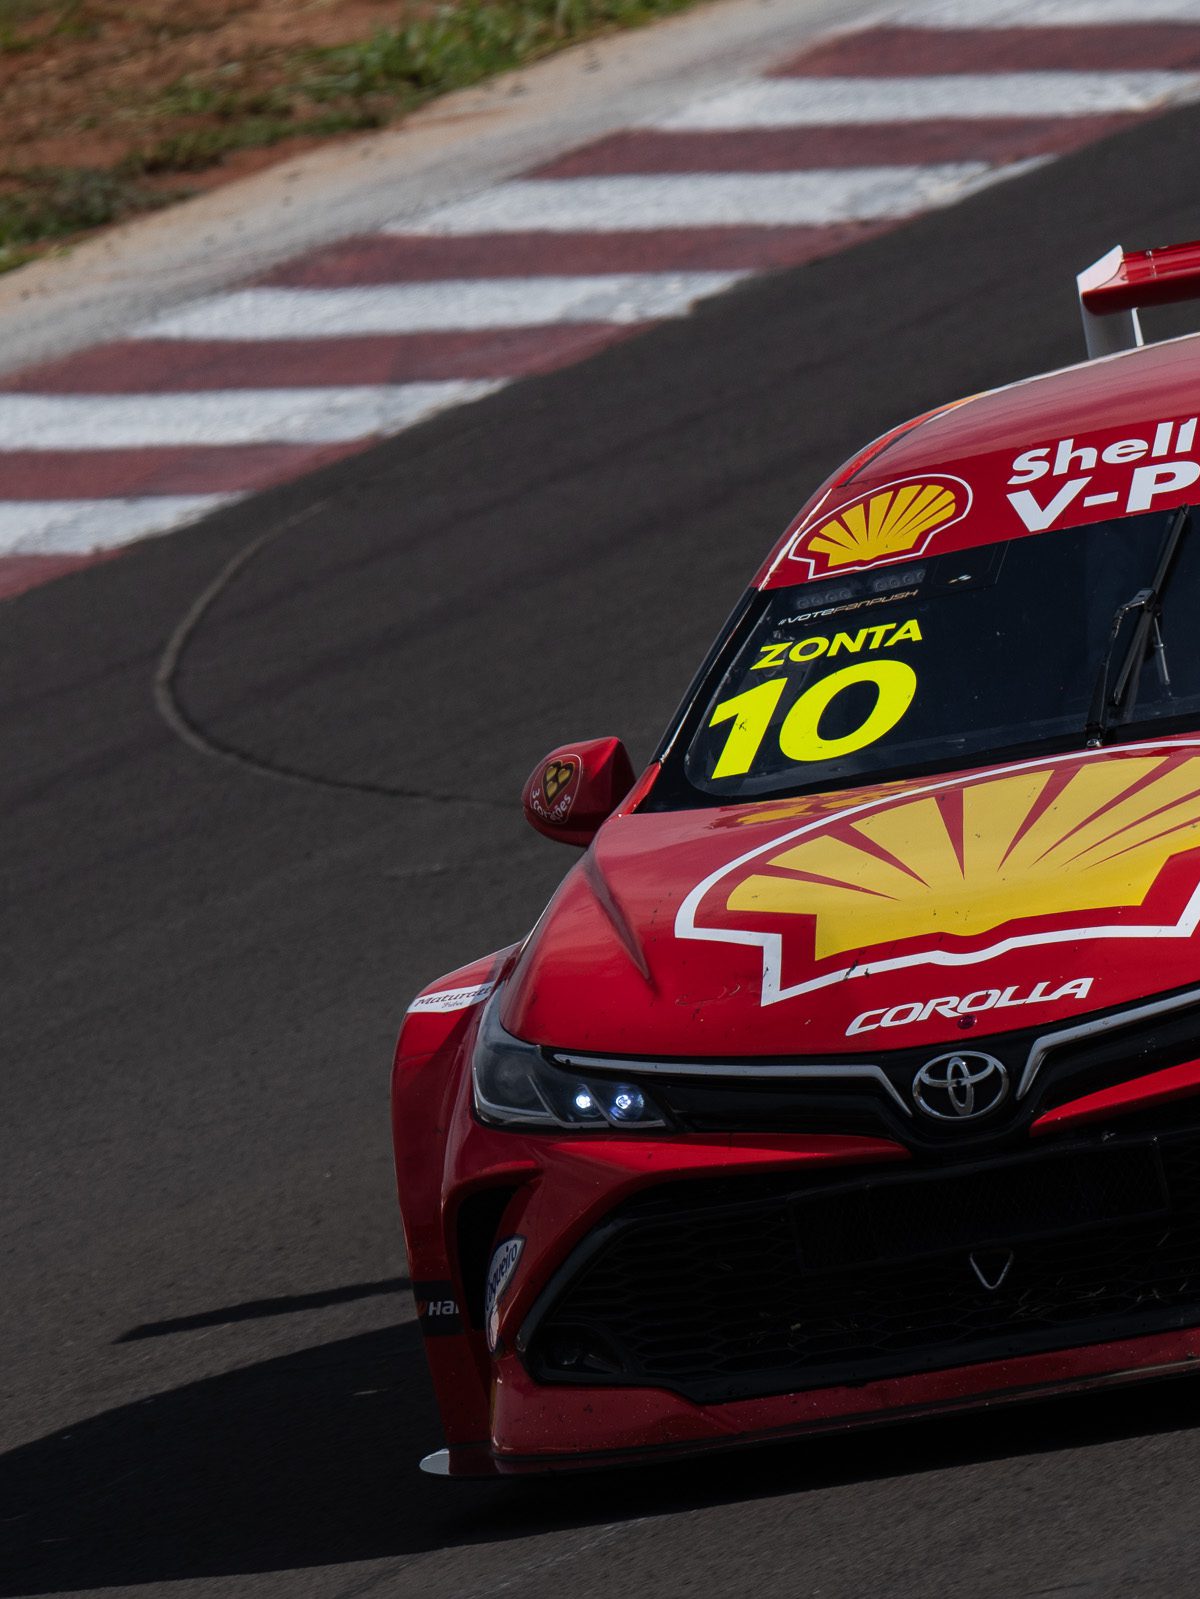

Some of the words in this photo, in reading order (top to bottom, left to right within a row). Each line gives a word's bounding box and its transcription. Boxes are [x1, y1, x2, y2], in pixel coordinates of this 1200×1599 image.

[1006, 416, 1198, 486] Shell
[749, 618, 923, 672] ZONTA
[708, 658, 918, 781] 10
[845, 977, 1095, 1037] COROLLA
